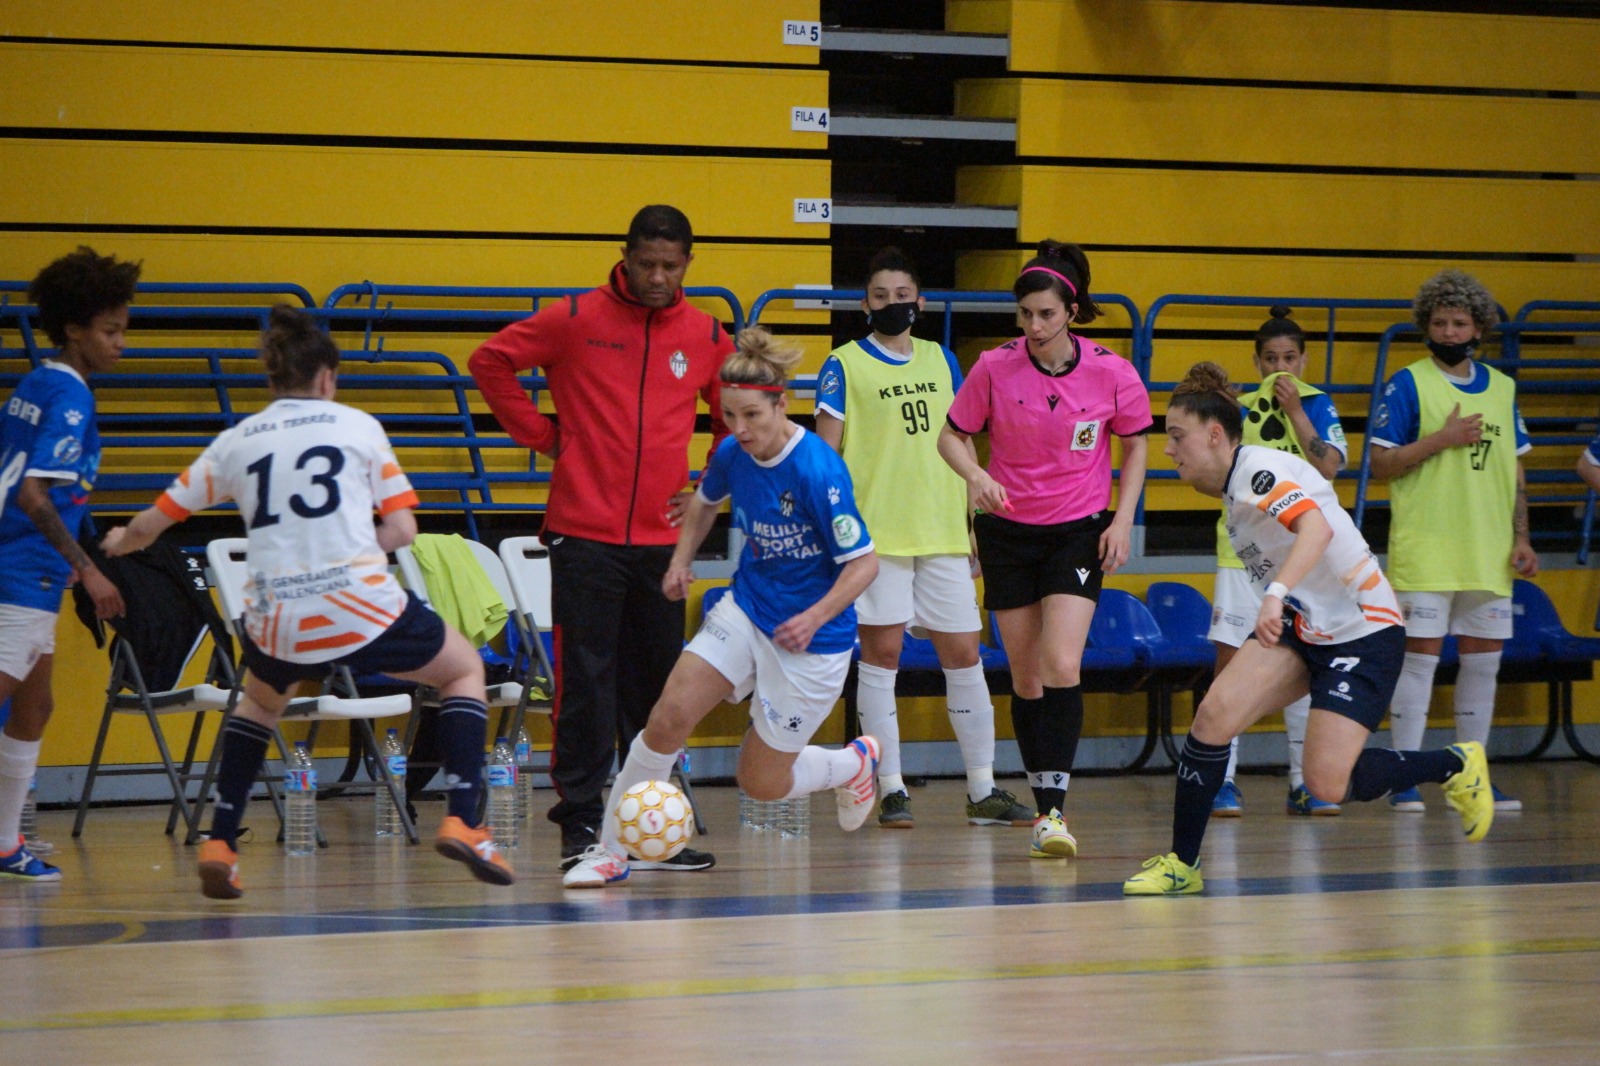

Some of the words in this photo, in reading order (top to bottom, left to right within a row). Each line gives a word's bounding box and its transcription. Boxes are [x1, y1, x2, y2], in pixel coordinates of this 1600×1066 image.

[787, 24, 806, 36] FILA
[810, 26, 819, 42] 5
[795, 111, 814, 122] FILA
[818, 112, 827, 128] 4
[798, 203, 817, 213] FILA
[821, 203, 830, 218] 3
[879, 382, 938, 399] KELME
[901, 399, 930, 435] 99
[244, 422, 278, 437] LARA
[246, 445, 346, 530] 13
